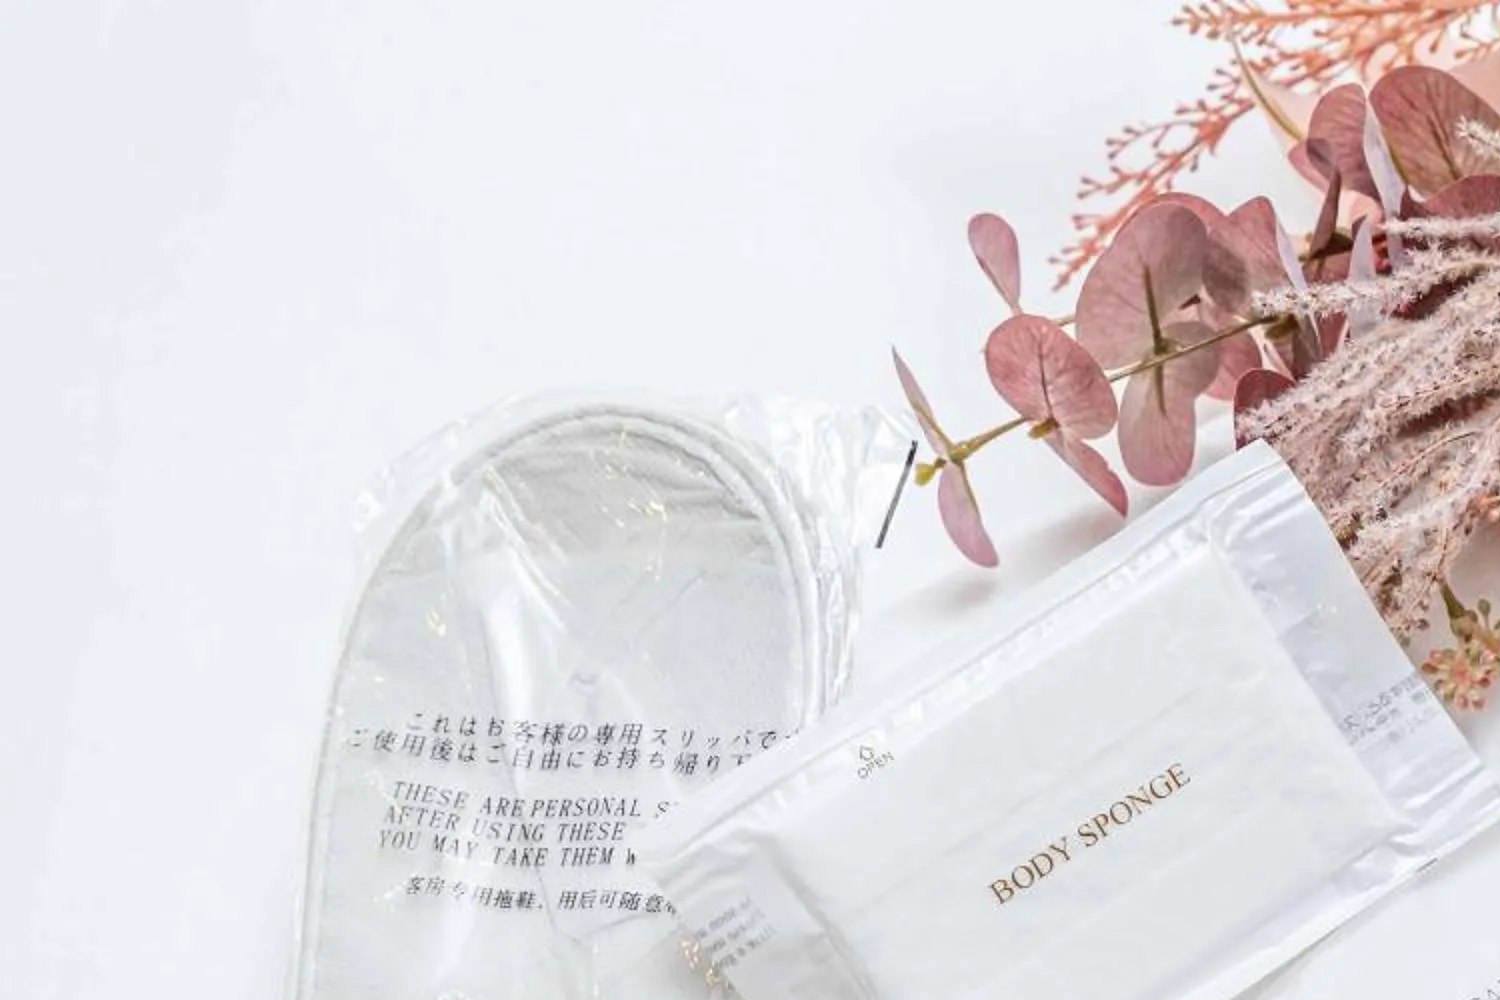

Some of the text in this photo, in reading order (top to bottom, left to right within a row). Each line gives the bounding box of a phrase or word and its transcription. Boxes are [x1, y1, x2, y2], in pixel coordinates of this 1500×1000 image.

[406, 713, 798, 749] これはお客様の専用スリッパで
[393, 781, 470, 809] THESE
[480, 796, 525, 817] ARE
[531, 797, 641, 817] PERSONAL
[384, 805, 627, 843] AFTER USING THESE
[989, 763, 1191, 904] BODY SPONGE
[378, 829, 421, 851] YOU
[432, 833, 480, 859] MAY
[493, 847, 549, 868] TAKE
[560, 847, 616, 868] THEM
